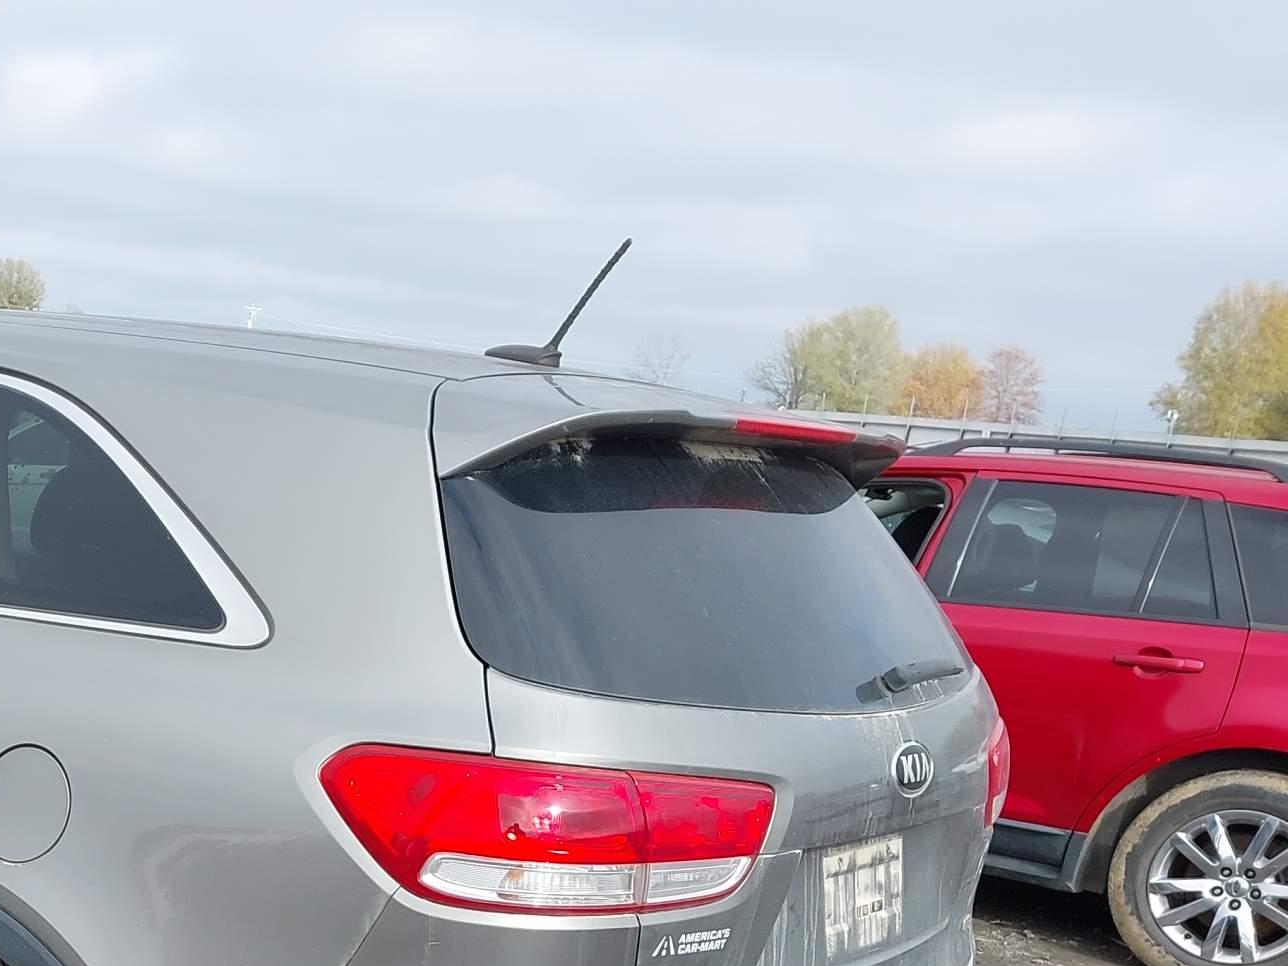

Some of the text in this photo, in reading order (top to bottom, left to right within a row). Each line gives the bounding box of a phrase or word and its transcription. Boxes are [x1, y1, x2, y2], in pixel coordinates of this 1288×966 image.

[899, 752, 930, 784] KIA
[678, 928, 731, 944] AMERICA'S
[677, 939, 727, 955] CAR-MART
